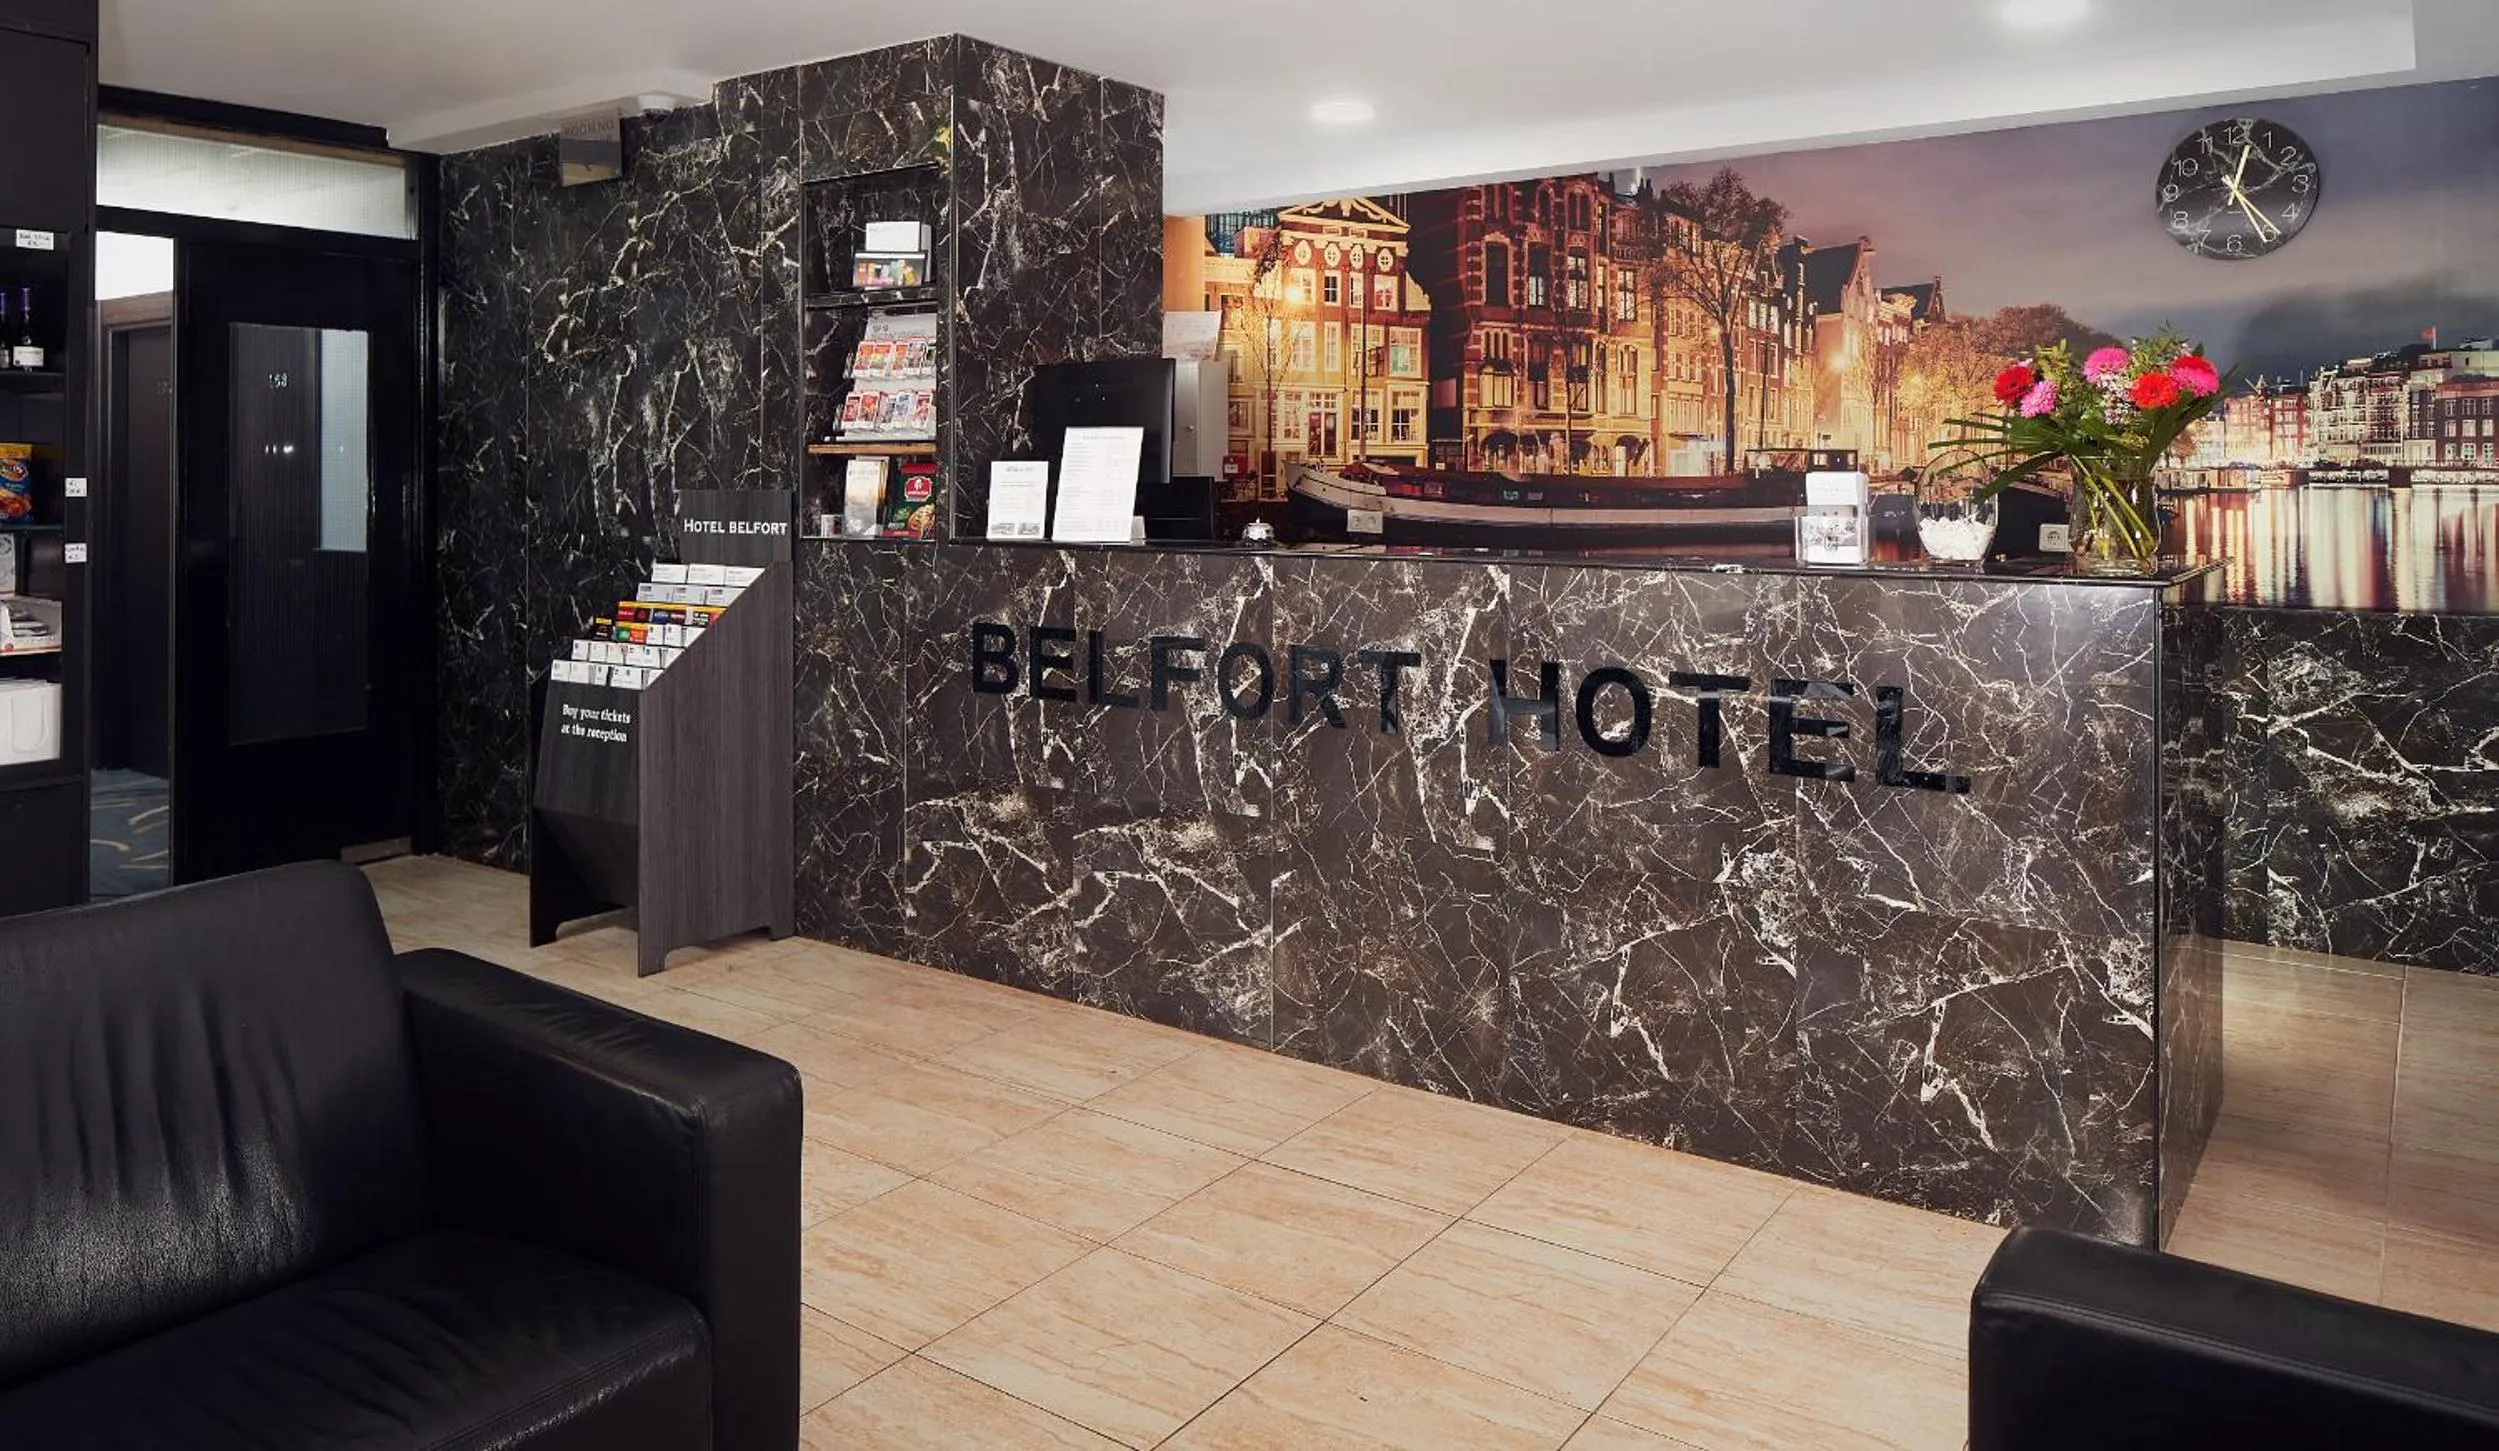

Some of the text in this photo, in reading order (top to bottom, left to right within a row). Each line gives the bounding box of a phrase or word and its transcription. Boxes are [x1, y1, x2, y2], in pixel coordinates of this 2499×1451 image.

[2197, 136, 2214, 154] 11
[2224, 126, 2243, 145] 12
[2263, 131, 2273, 150] 1
[2280, 146, 2297, 166] 2
[2174, 158, 2199, 177] 10
[2163, 183, 2180, 202] 9
[2292, 174, 2309, 193] 3
[2173, 211, 2188, 229] 8
[2281, 203, 2298, 222] 4
[2200, 229, 2212, 248] 7
[2226, 234, 2243, 253] 6
[684, 518, 788, 536] HOTEL BELFORT
[562, 703, 631, 724] Buy your tickets
[972, 621, 1972, 793] BELFORT HOTEL
[561, 723, 628, 743] at the reception
